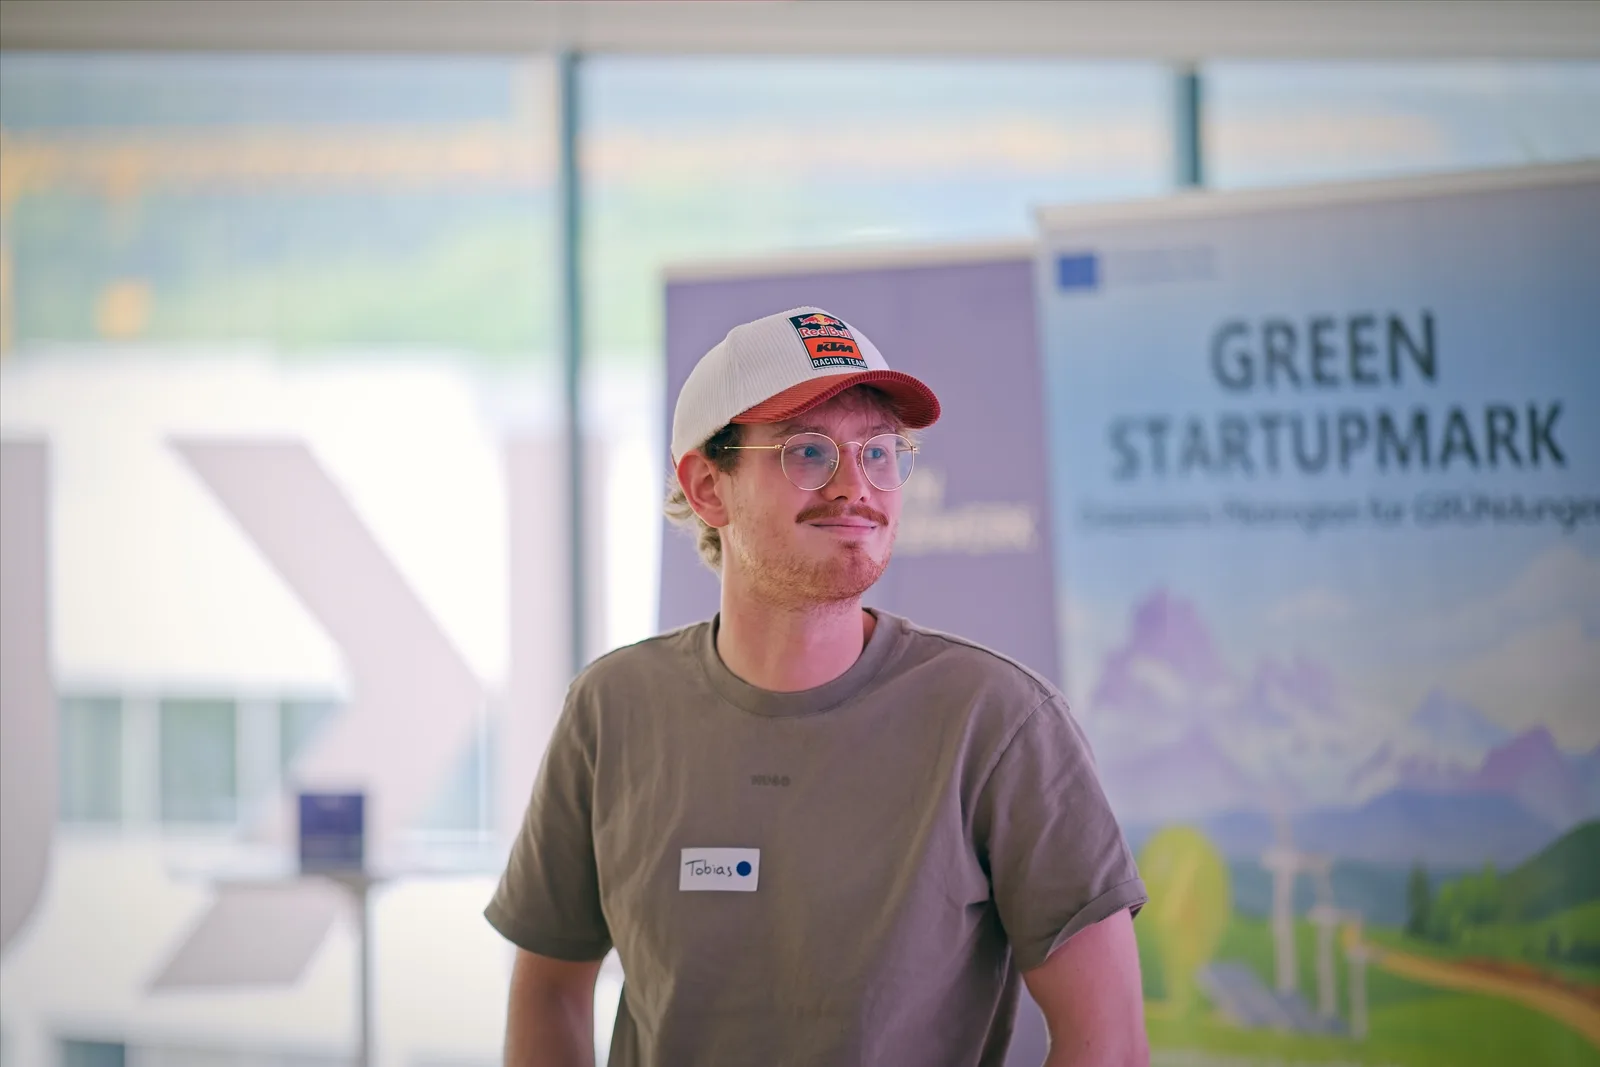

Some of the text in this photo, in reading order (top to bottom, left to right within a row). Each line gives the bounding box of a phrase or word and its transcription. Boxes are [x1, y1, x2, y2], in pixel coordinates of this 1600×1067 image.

[799, 325, 853, 340] Red Bull
[816, 341, 854, 354] KTM
[1208, 307, 1438, 393] GREEN
[813, 357, 866, 368] RACING TEAM
[1108, 400, 1568, 481] STARTUPMARK
[685, 859, 732, 877] Tobias
